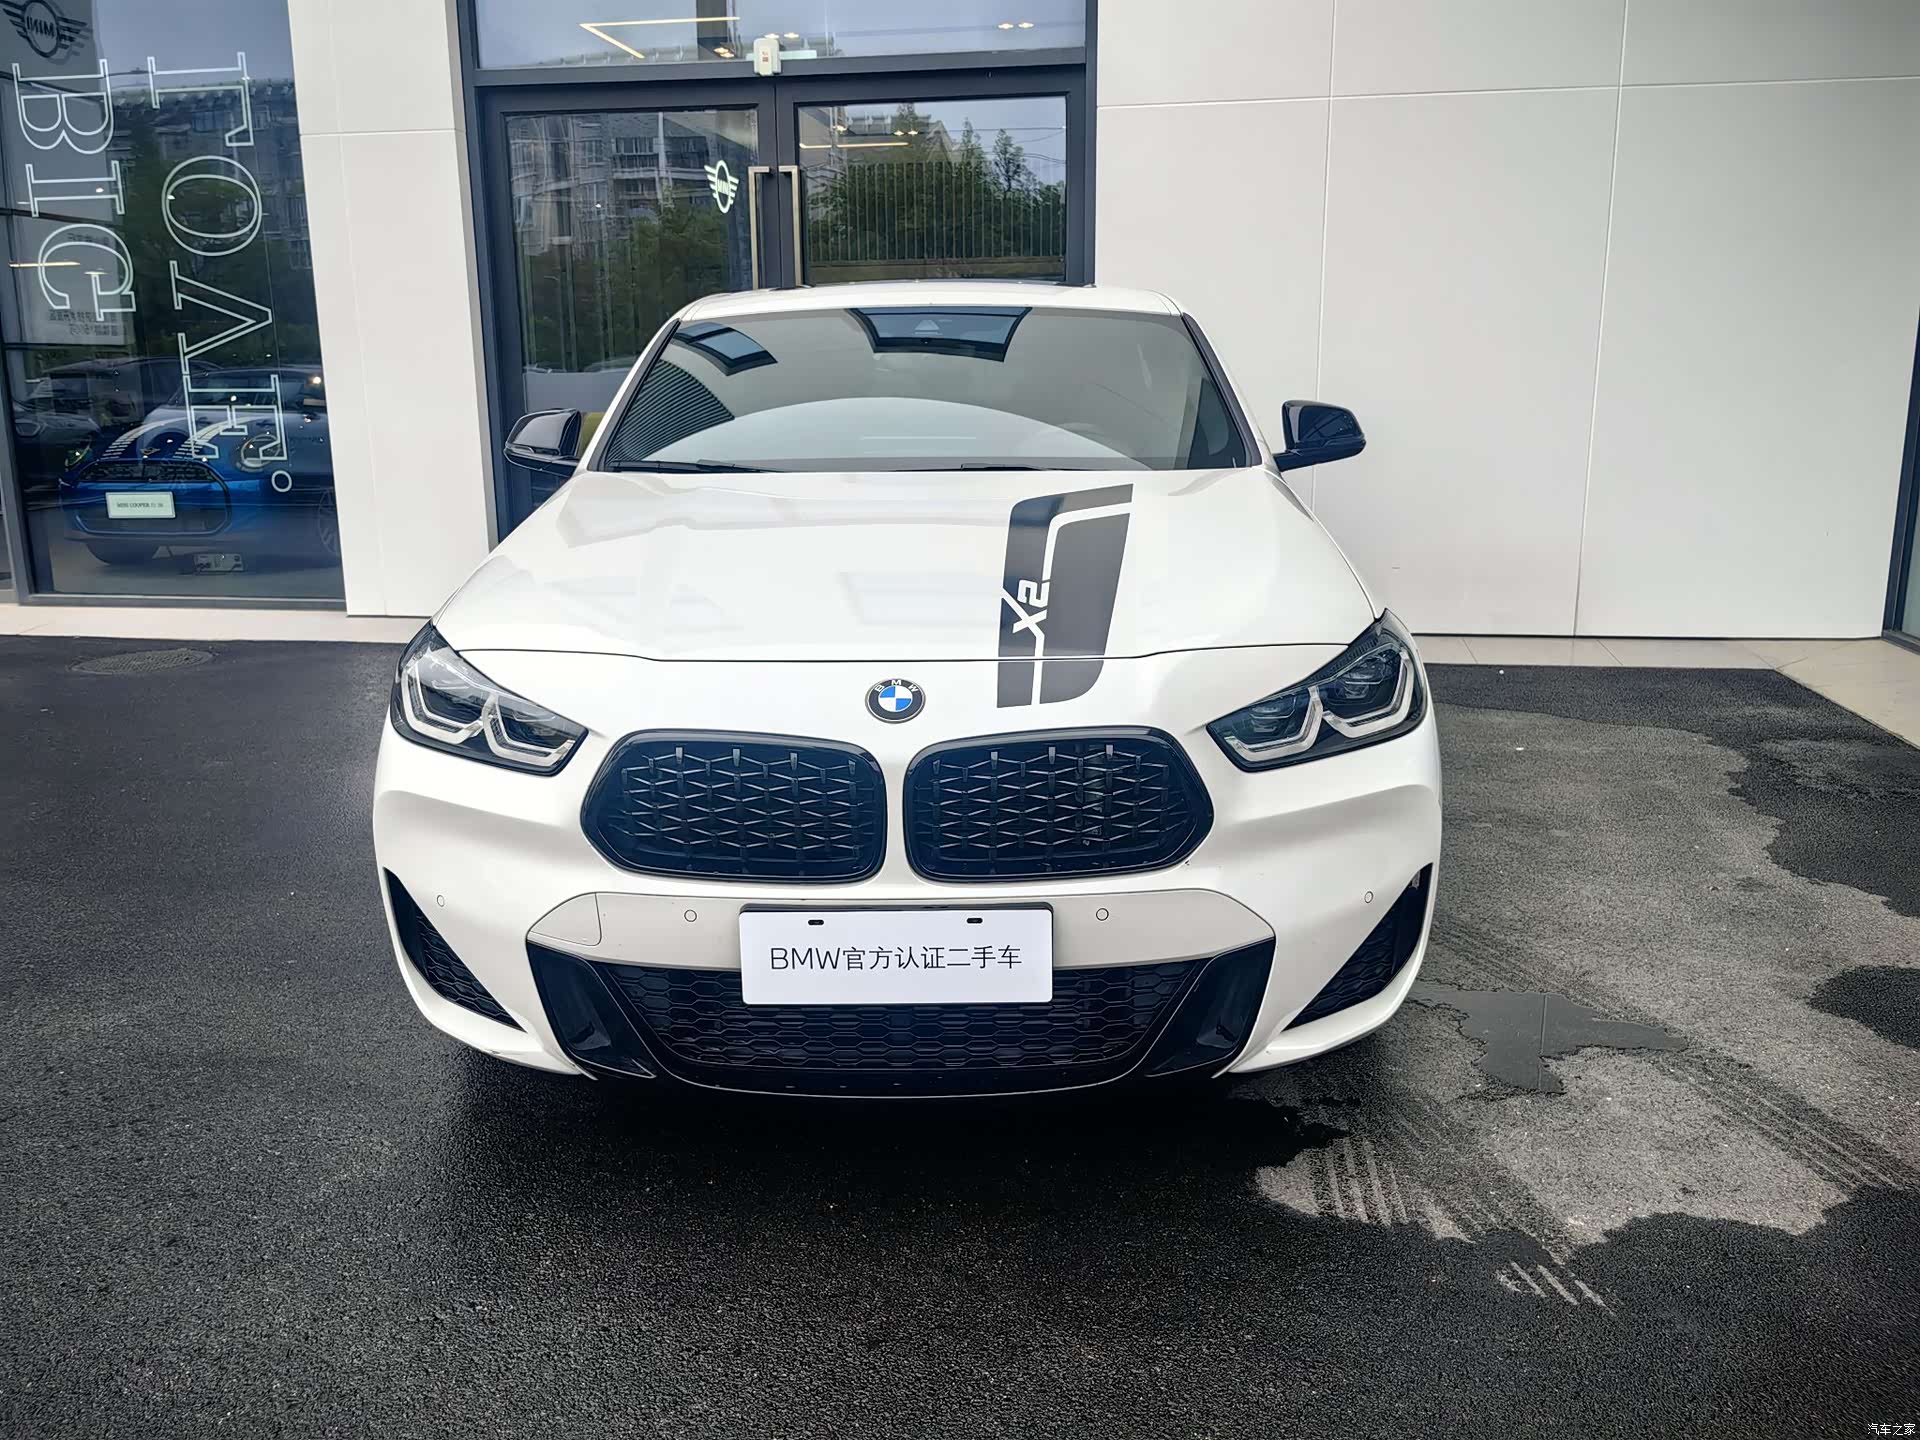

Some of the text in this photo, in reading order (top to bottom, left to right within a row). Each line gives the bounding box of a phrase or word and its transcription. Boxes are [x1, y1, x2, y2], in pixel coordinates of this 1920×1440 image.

[1001, 579, 1050, 638] X2
[874, 679, 919, 693] BMW
[770, 944, 1022, 971] BMW官方认证二手车
